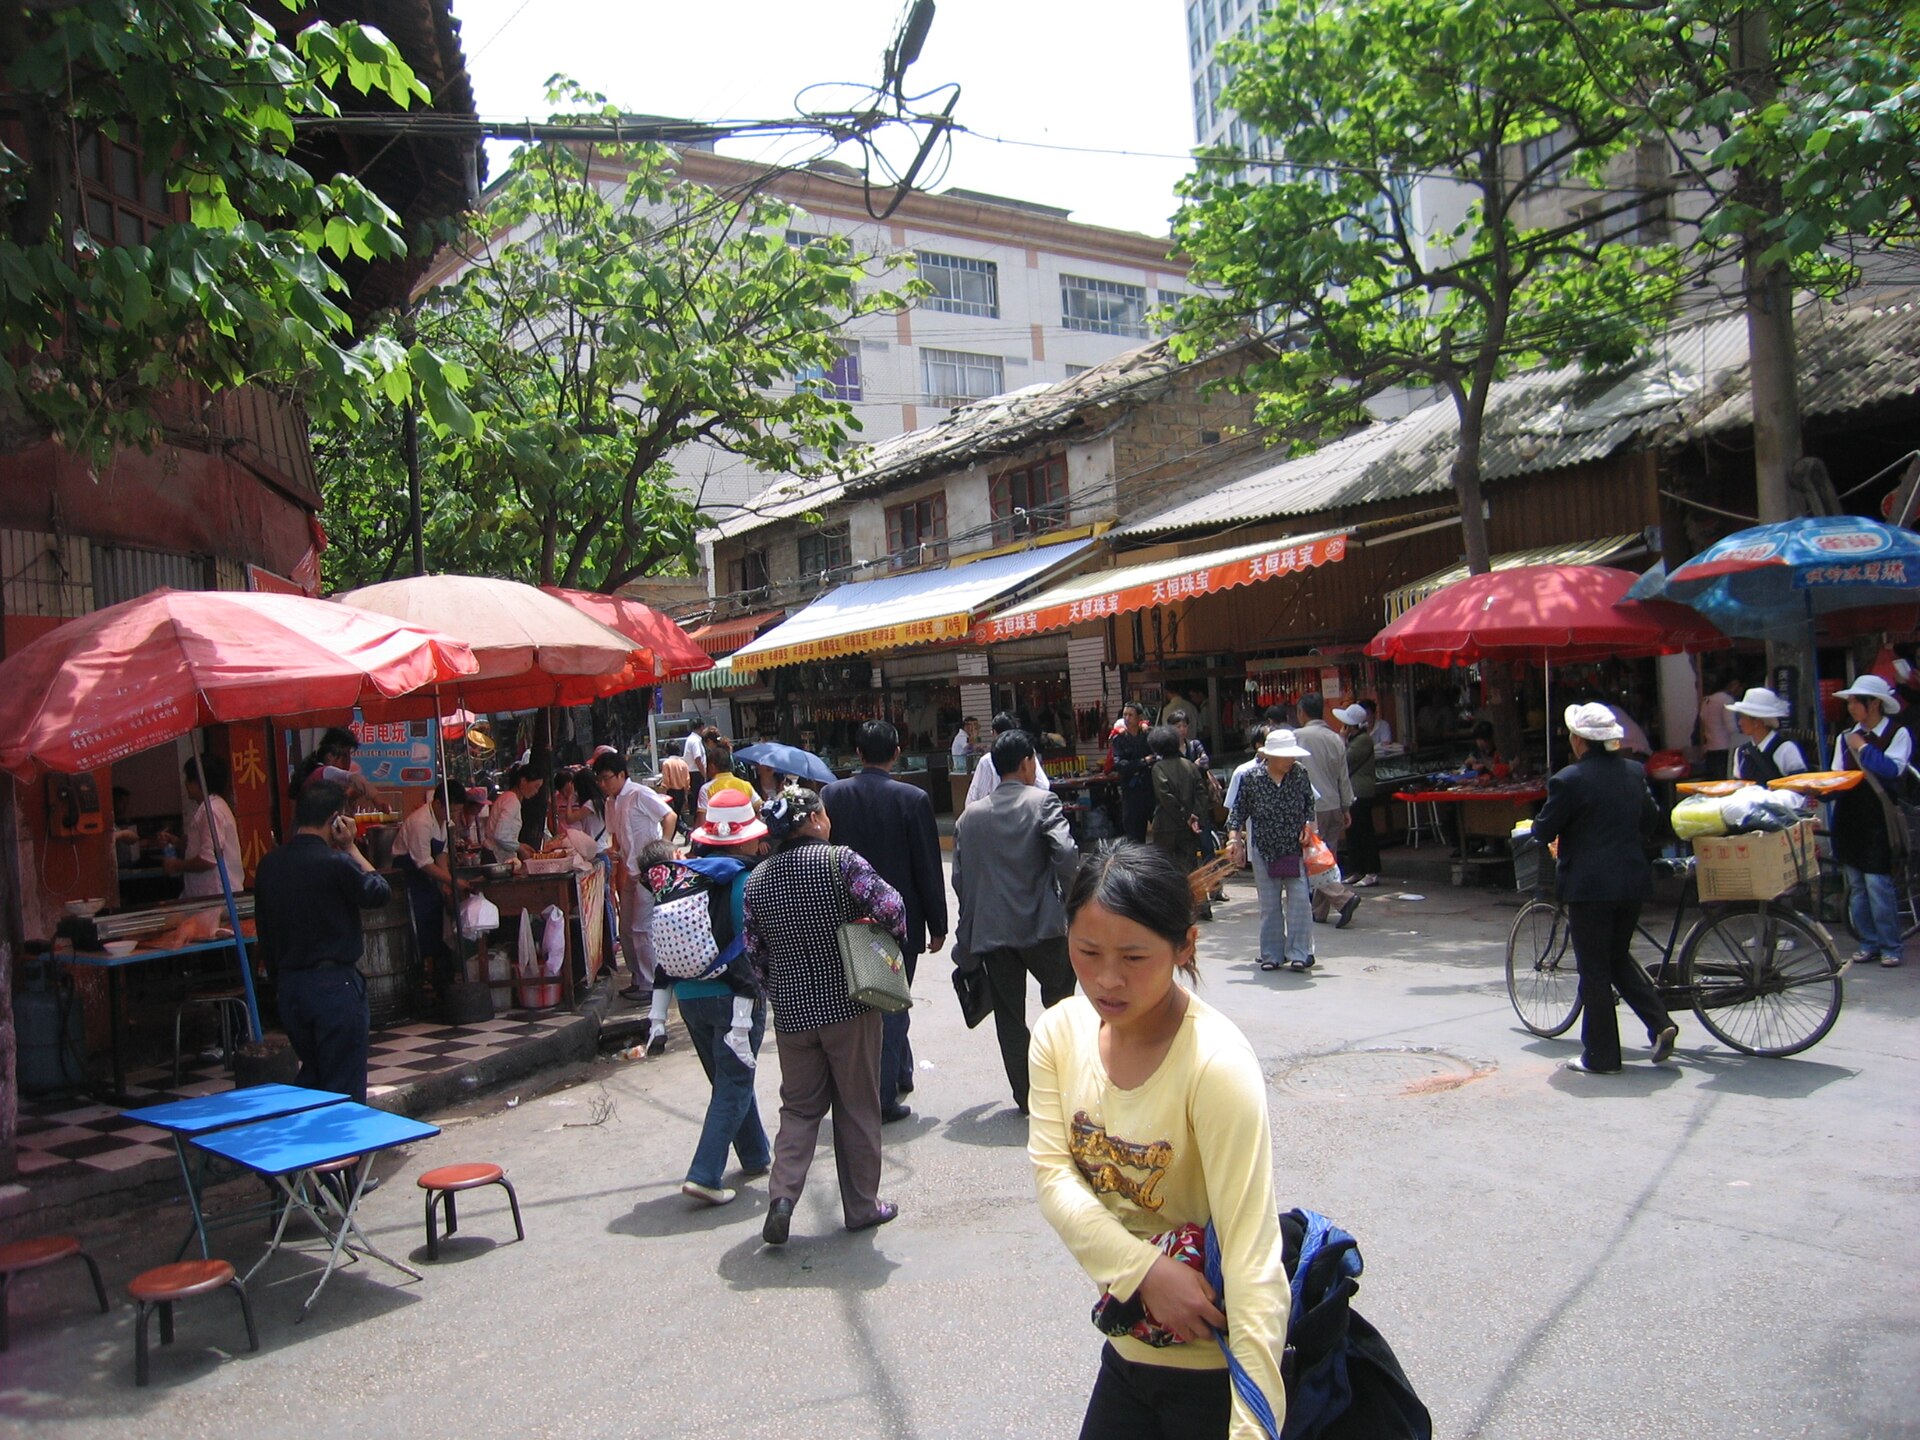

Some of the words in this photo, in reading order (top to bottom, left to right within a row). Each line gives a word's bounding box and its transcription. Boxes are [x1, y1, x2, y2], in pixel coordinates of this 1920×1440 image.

[993, 613, 1037, 635] 天恒珠宝
[1068, 594, 1119, 620] 天恒珠宝
[1152, 571, 1209, 600] 天恒珠宝
[1249, 545, 1314, 578] 天恒珠宝
